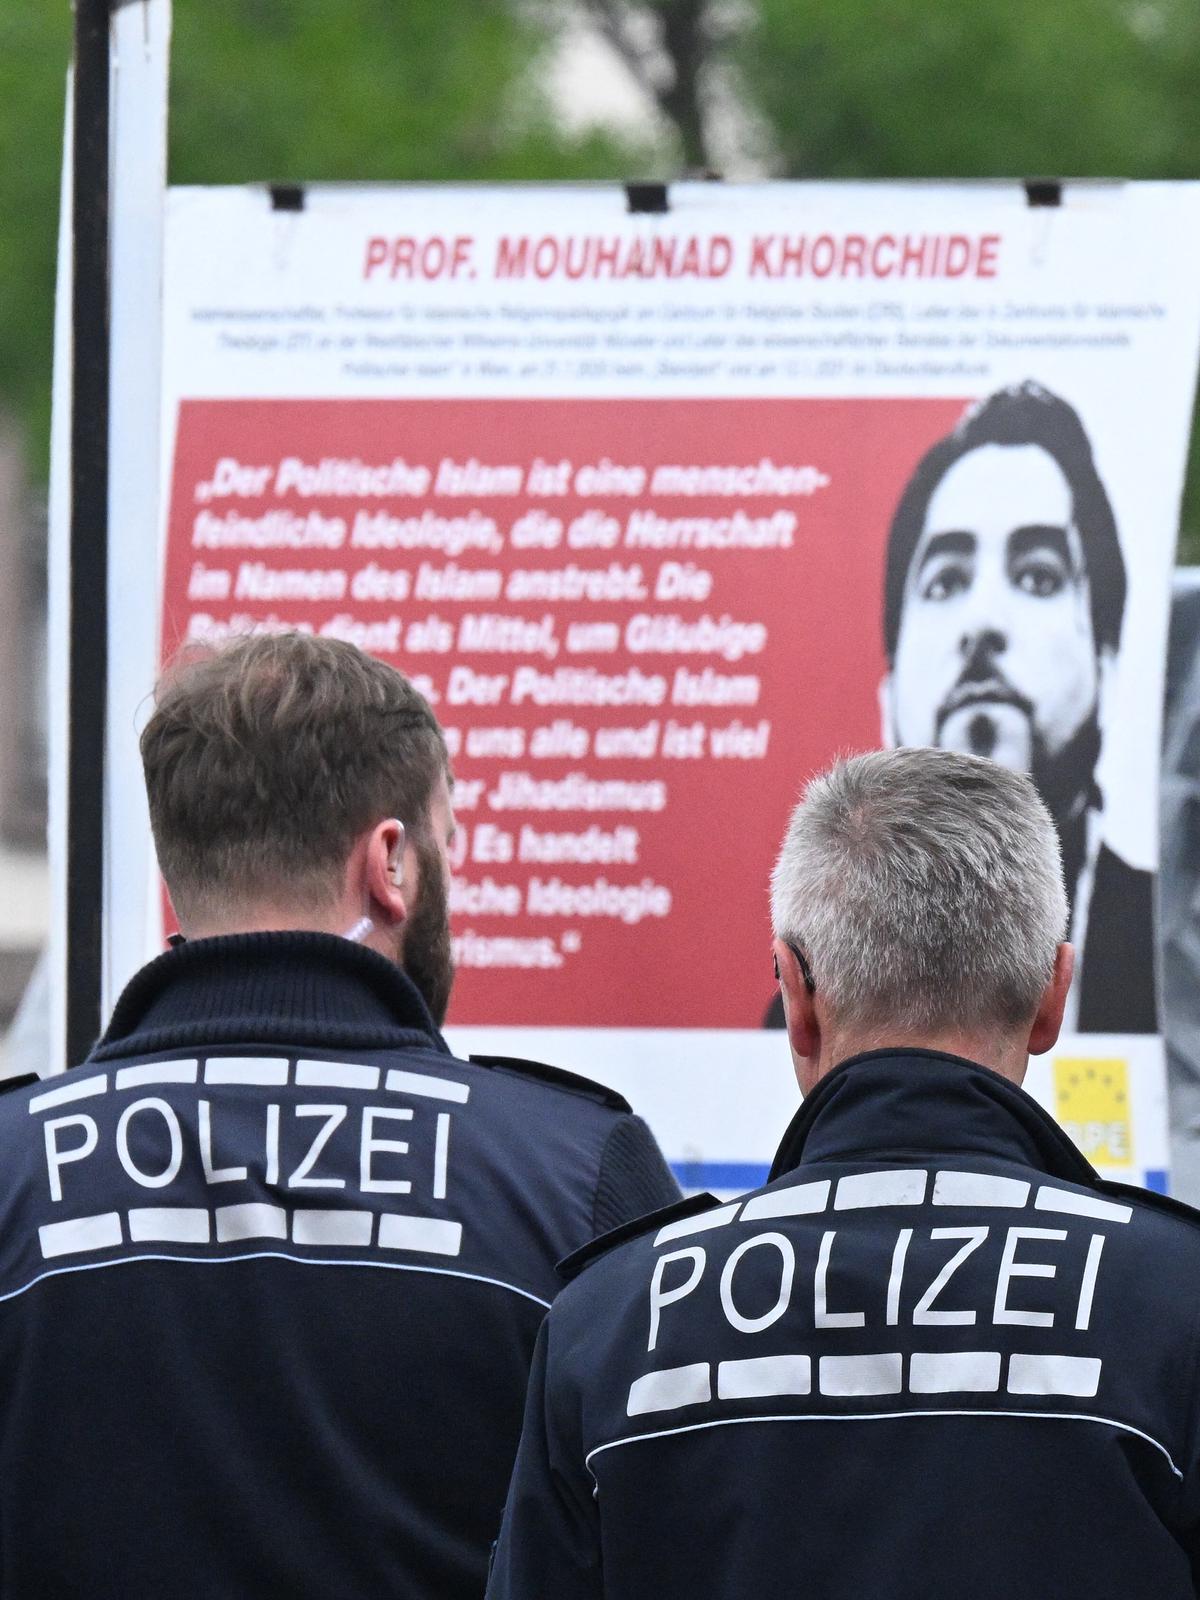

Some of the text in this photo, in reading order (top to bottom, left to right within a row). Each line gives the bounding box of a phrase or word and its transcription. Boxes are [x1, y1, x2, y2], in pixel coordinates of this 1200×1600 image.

[364, 232, 1001, 282] PROF. MOUHANAD KHORCHIDE
[275, 457, 431, 497] Politische
[434, 458, 524, 497] Islam
[526, 458, 572, 497] ist
[574, 458, 647, 497] eine
[650, 457, 830, 496] menschen-
[192, 510, 798, 556] feindliche Ideologie, die die Herrschaft
[188, 561, 713, 601] im Namen des Islam anstrebt. Die
[405, 615, 453, 653] als
[458, 614, 559, 658] Mittel,
[566, 622, 620, 653] um
[625, 614, 767, 661] Gläubige
[446, 667, 508, 705] Der
[511, 667, 667, 706] Politische
[672, 668, 760, 706] Islam
[466, 727, 525, 758] uns
[530, 720, 589, 758] alle
[595, 720, 659, 758] und
[662, 721, 706, 758] ist
[711, 720, 770, 759] viel
[488, 773, 666, 811] Jihadismus
[472, 824, 512, 862] Es
[519, 826, 638, 863] handelt
[527, 878, 670, 923] Ideologie
[44, 1097, 450, 1202] POLIZEI
[648, 1225, 1106, 1352] POLIZEI
